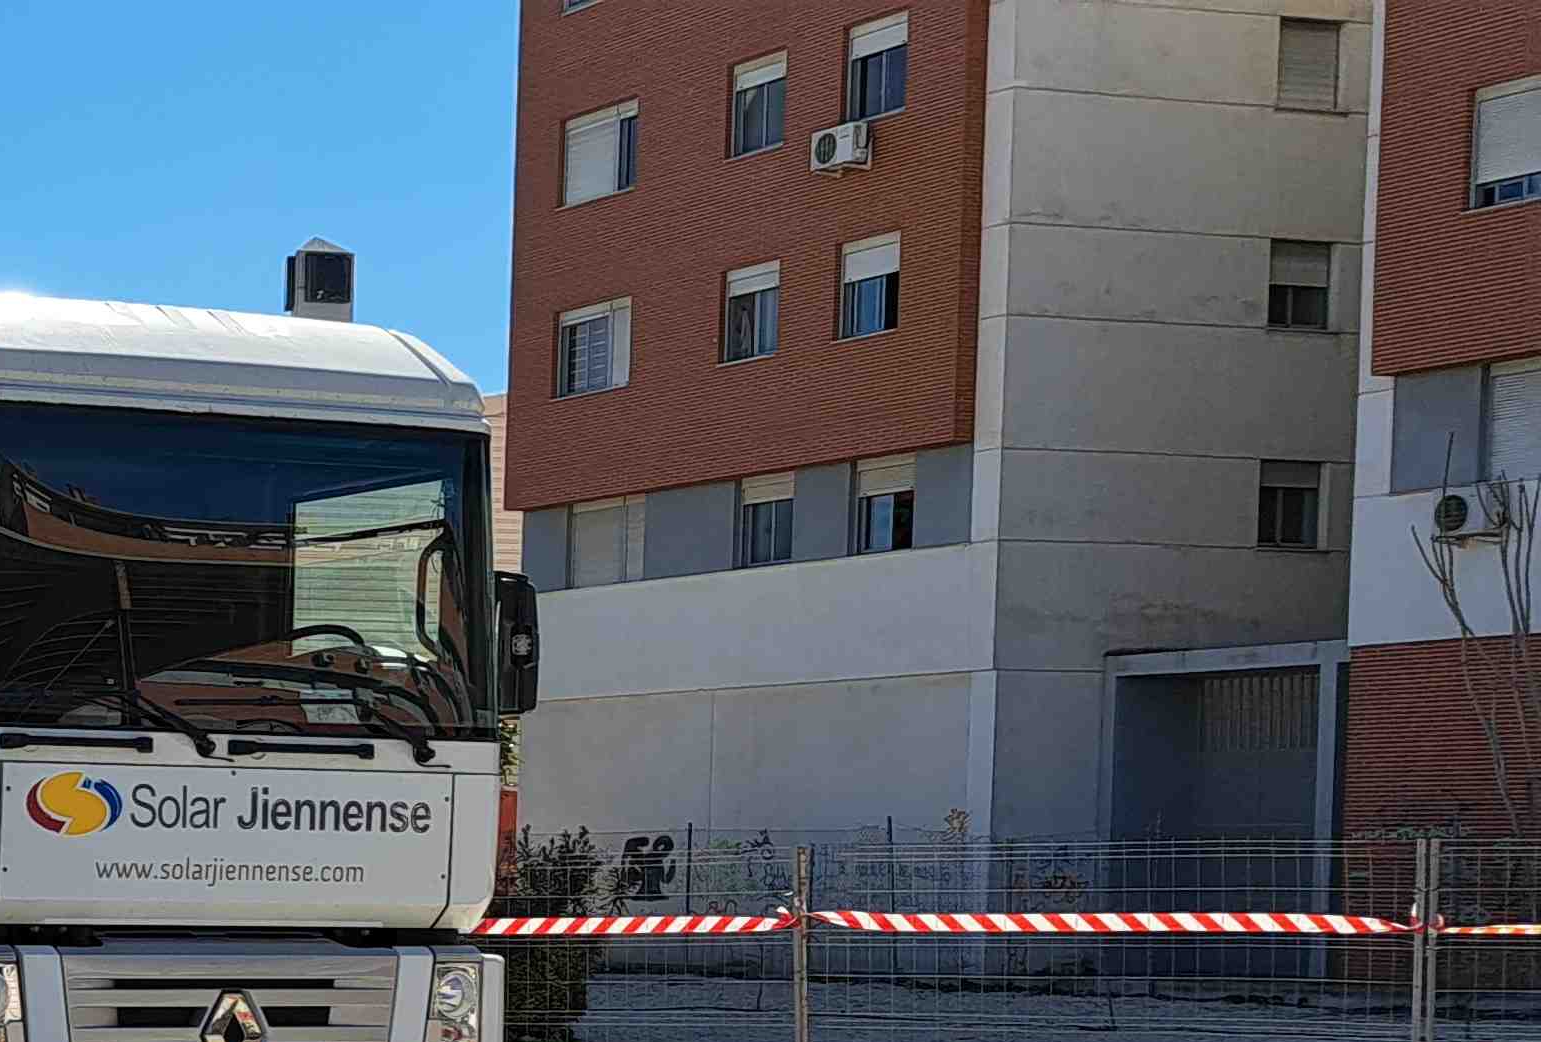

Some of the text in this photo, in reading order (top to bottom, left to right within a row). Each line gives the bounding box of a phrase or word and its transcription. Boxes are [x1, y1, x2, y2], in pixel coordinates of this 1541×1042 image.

[129, 783, 432, 834] Solar Jiennense
[95, 857, 365, 887] www.solarjiennense.com
